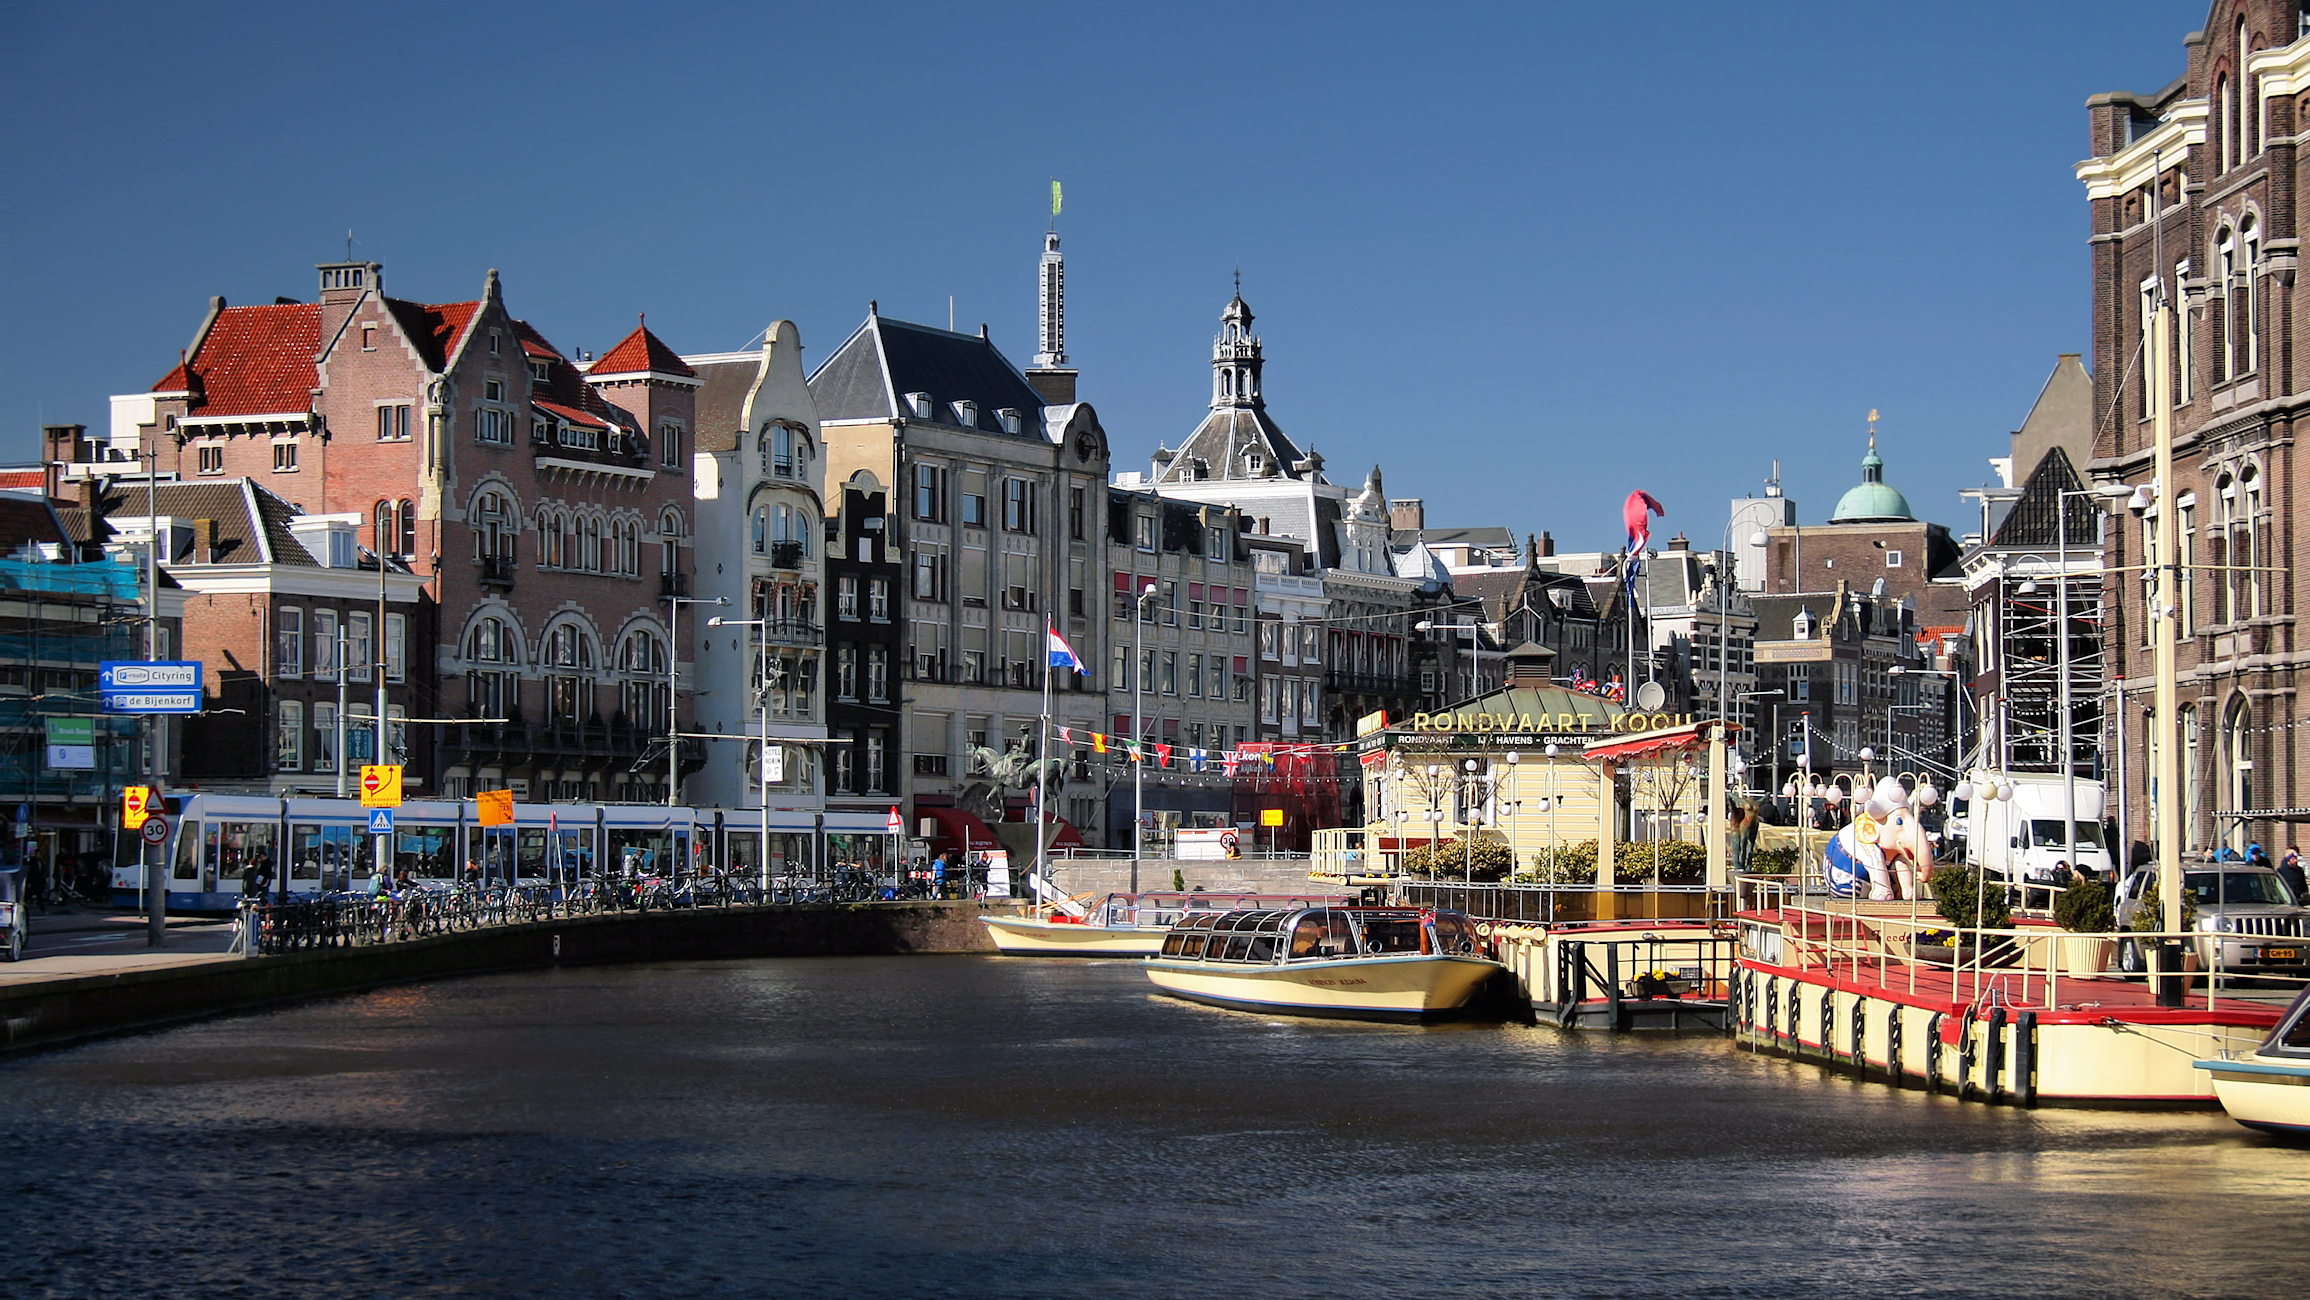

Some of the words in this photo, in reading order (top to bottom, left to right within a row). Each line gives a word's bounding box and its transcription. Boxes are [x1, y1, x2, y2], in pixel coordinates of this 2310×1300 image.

[152, 671, 192, 682] Cityring
[129, 697, 141, 705] de
[145, 696, 191, 706] Bijenkorf
[1414, 713, 1593, 733] RONDVAART
[1398, 735, 1454, 744] RONDVAART
[1496, 736, 1533, 744] HAVENS
[1543, 735, 1595, 744] GRACHTEN
[765, 748, 781, 756] HOTEL
[146, 824, 165, 836] 30
